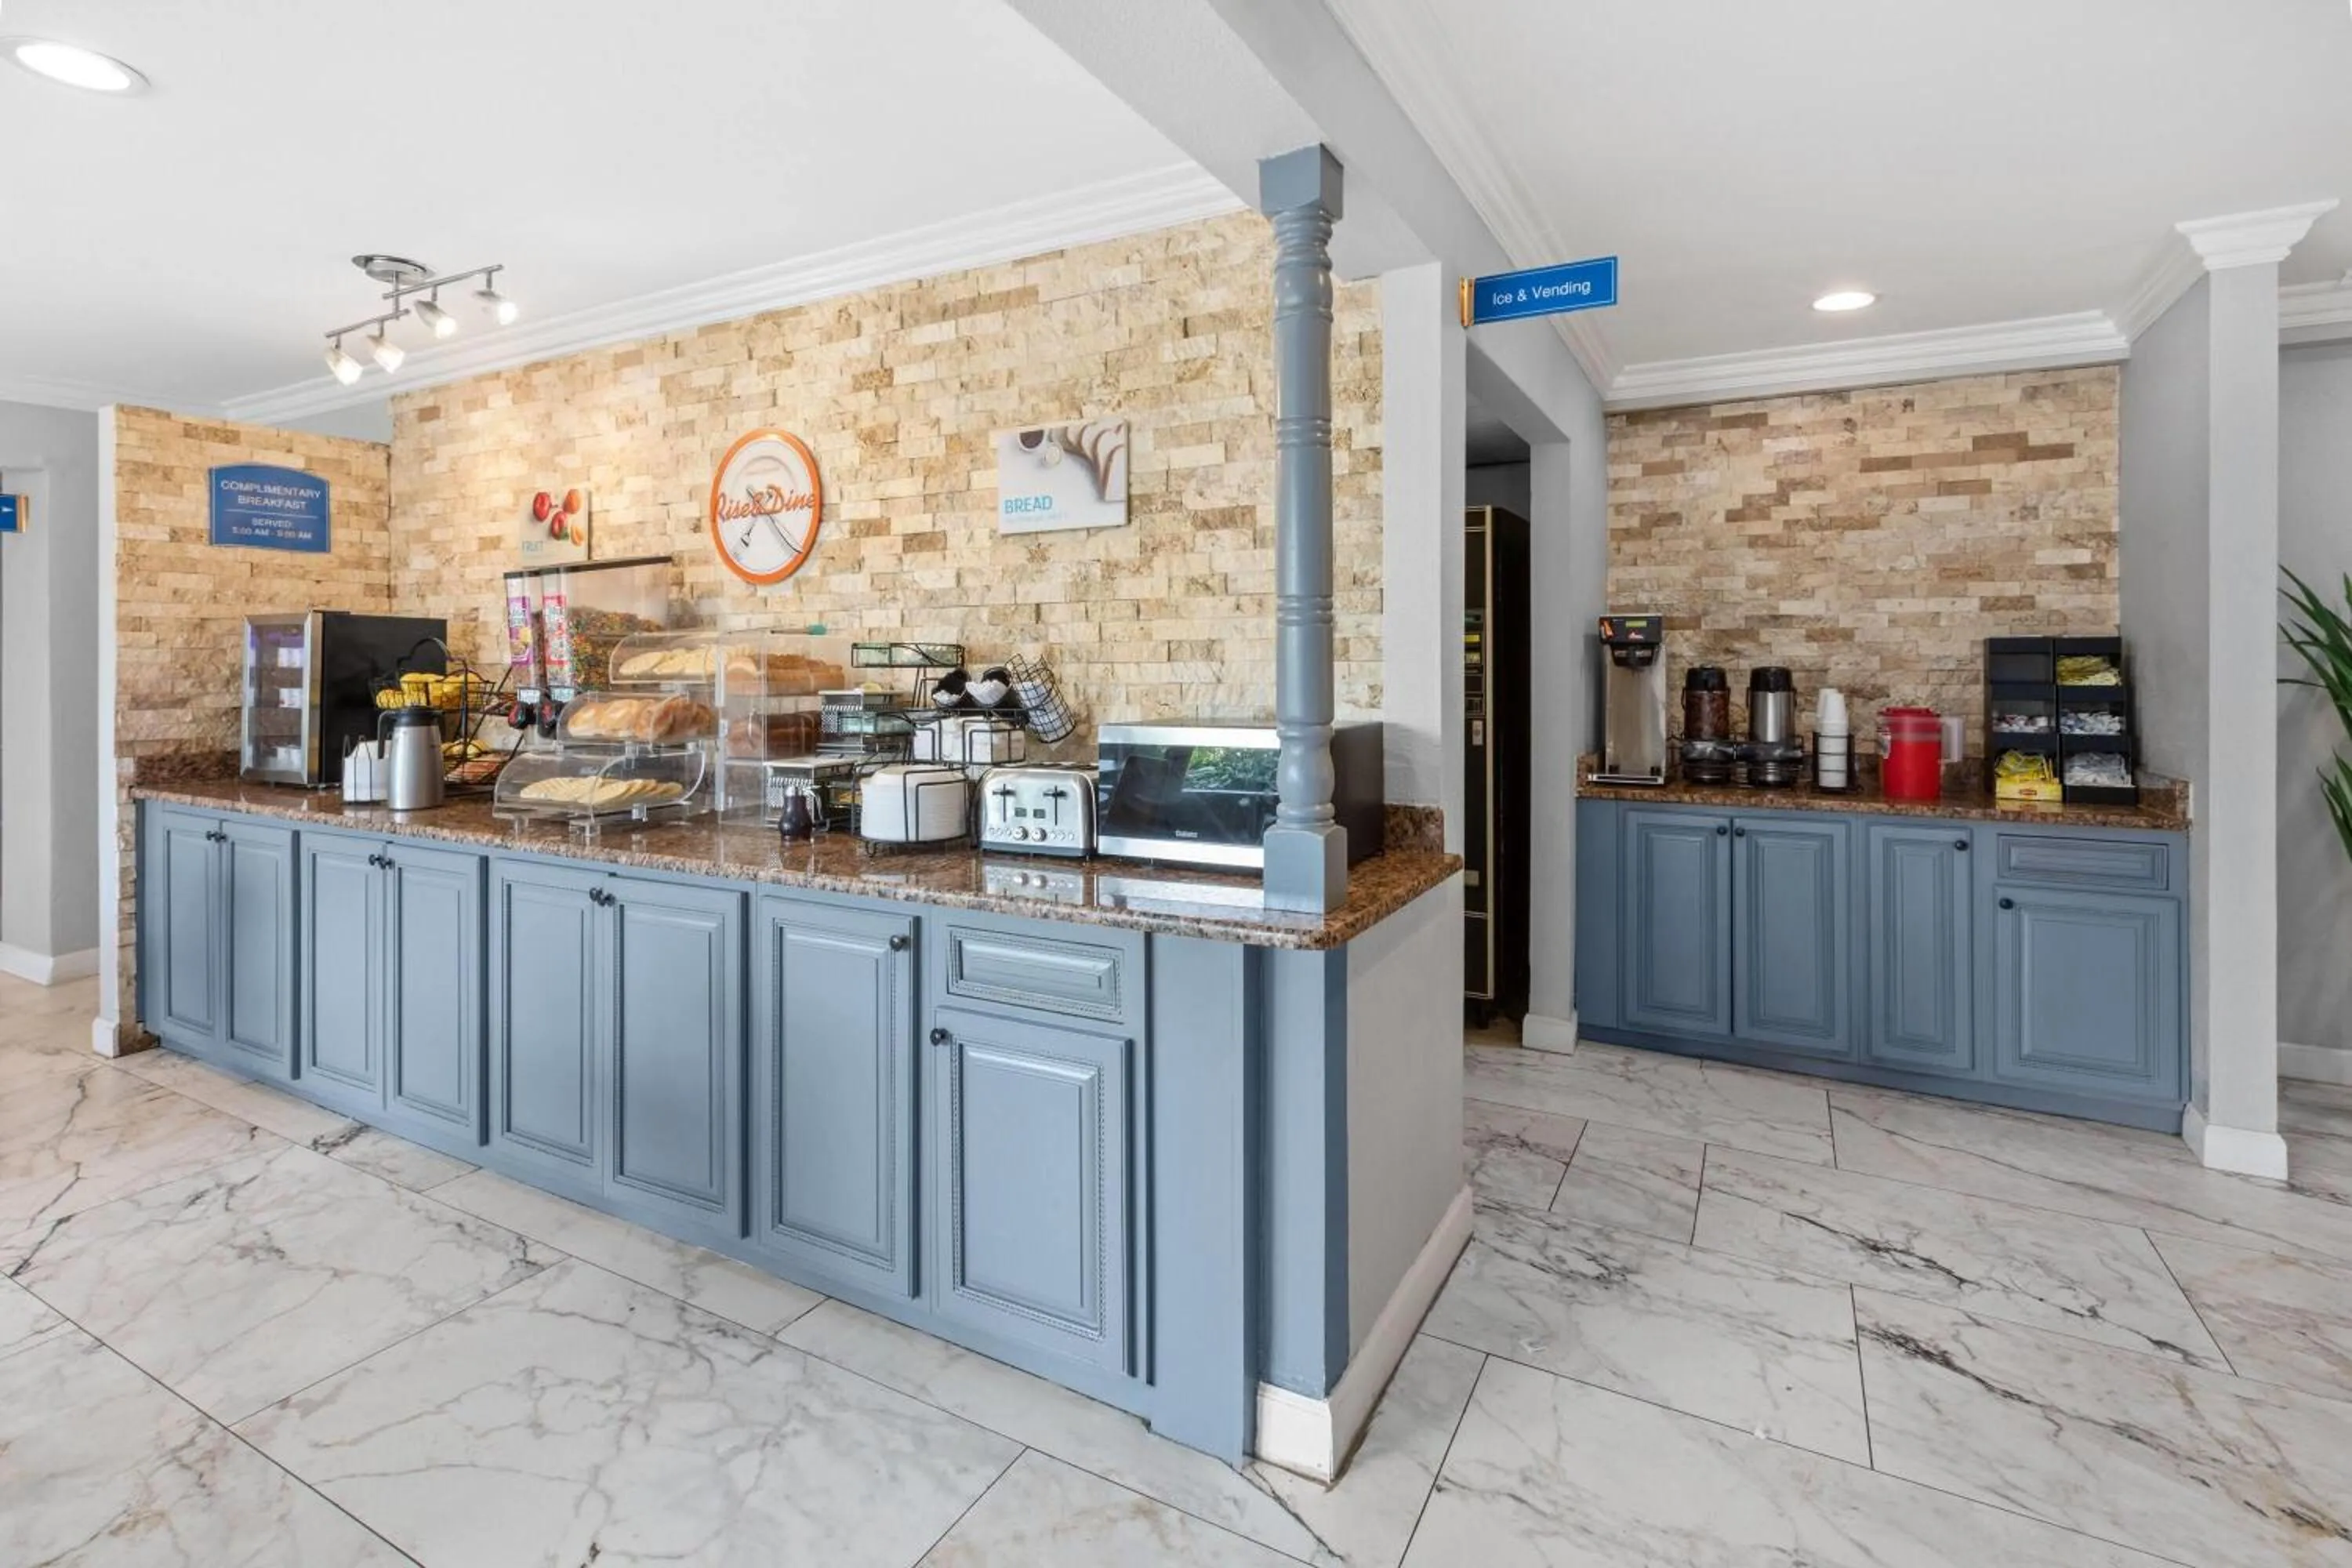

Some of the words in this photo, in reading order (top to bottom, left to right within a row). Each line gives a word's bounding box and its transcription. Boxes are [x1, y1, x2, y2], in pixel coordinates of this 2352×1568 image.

[1493, 292, 1512, 305] Ice
[1517, 289, 1527, 302] &
[1532, 281, 1591, 299] Vending
[220, 479, 321, 499] COMPLIMENTARY
[238, 495, 307, 510] BREAKFAST
[1004, 495, 1053, 514] BREAD
